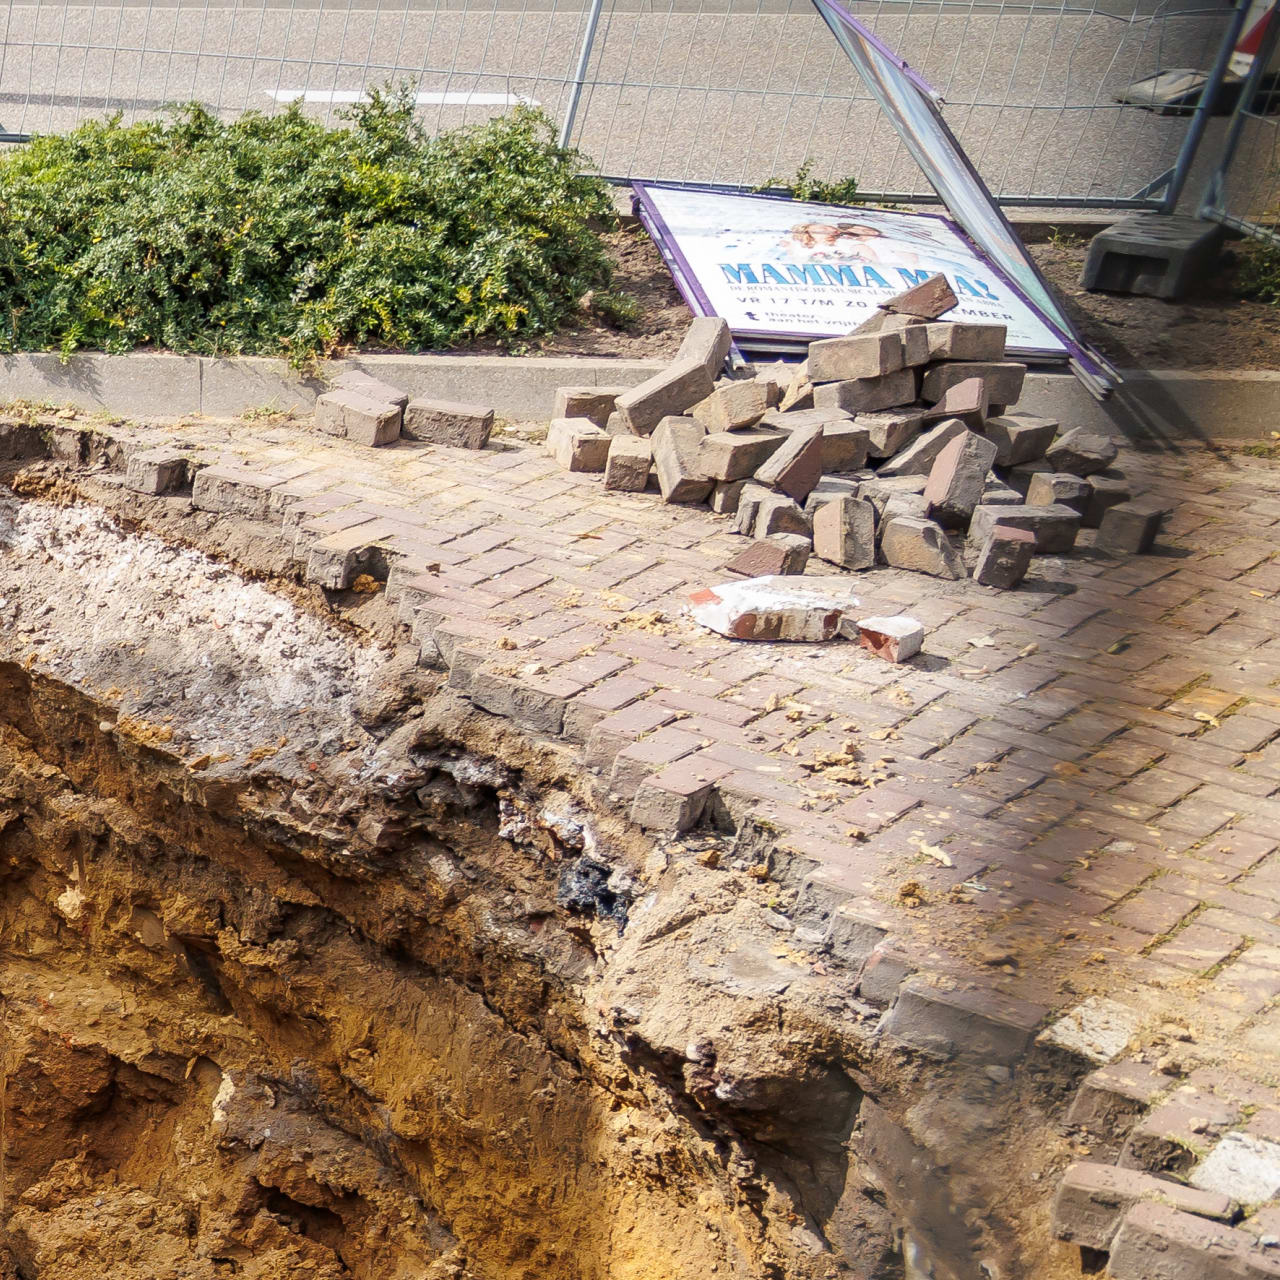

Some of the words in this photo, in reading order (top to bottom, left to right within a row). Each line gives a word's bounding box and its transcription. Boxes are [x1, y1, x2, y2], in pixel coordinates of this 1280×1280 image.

[717, 263, 896, 288] MAMMA
[892, 267, 1000, 301] MA!
[844, 300, 868, 308] ZO
[951, 307, 1016, 321] EMBER
